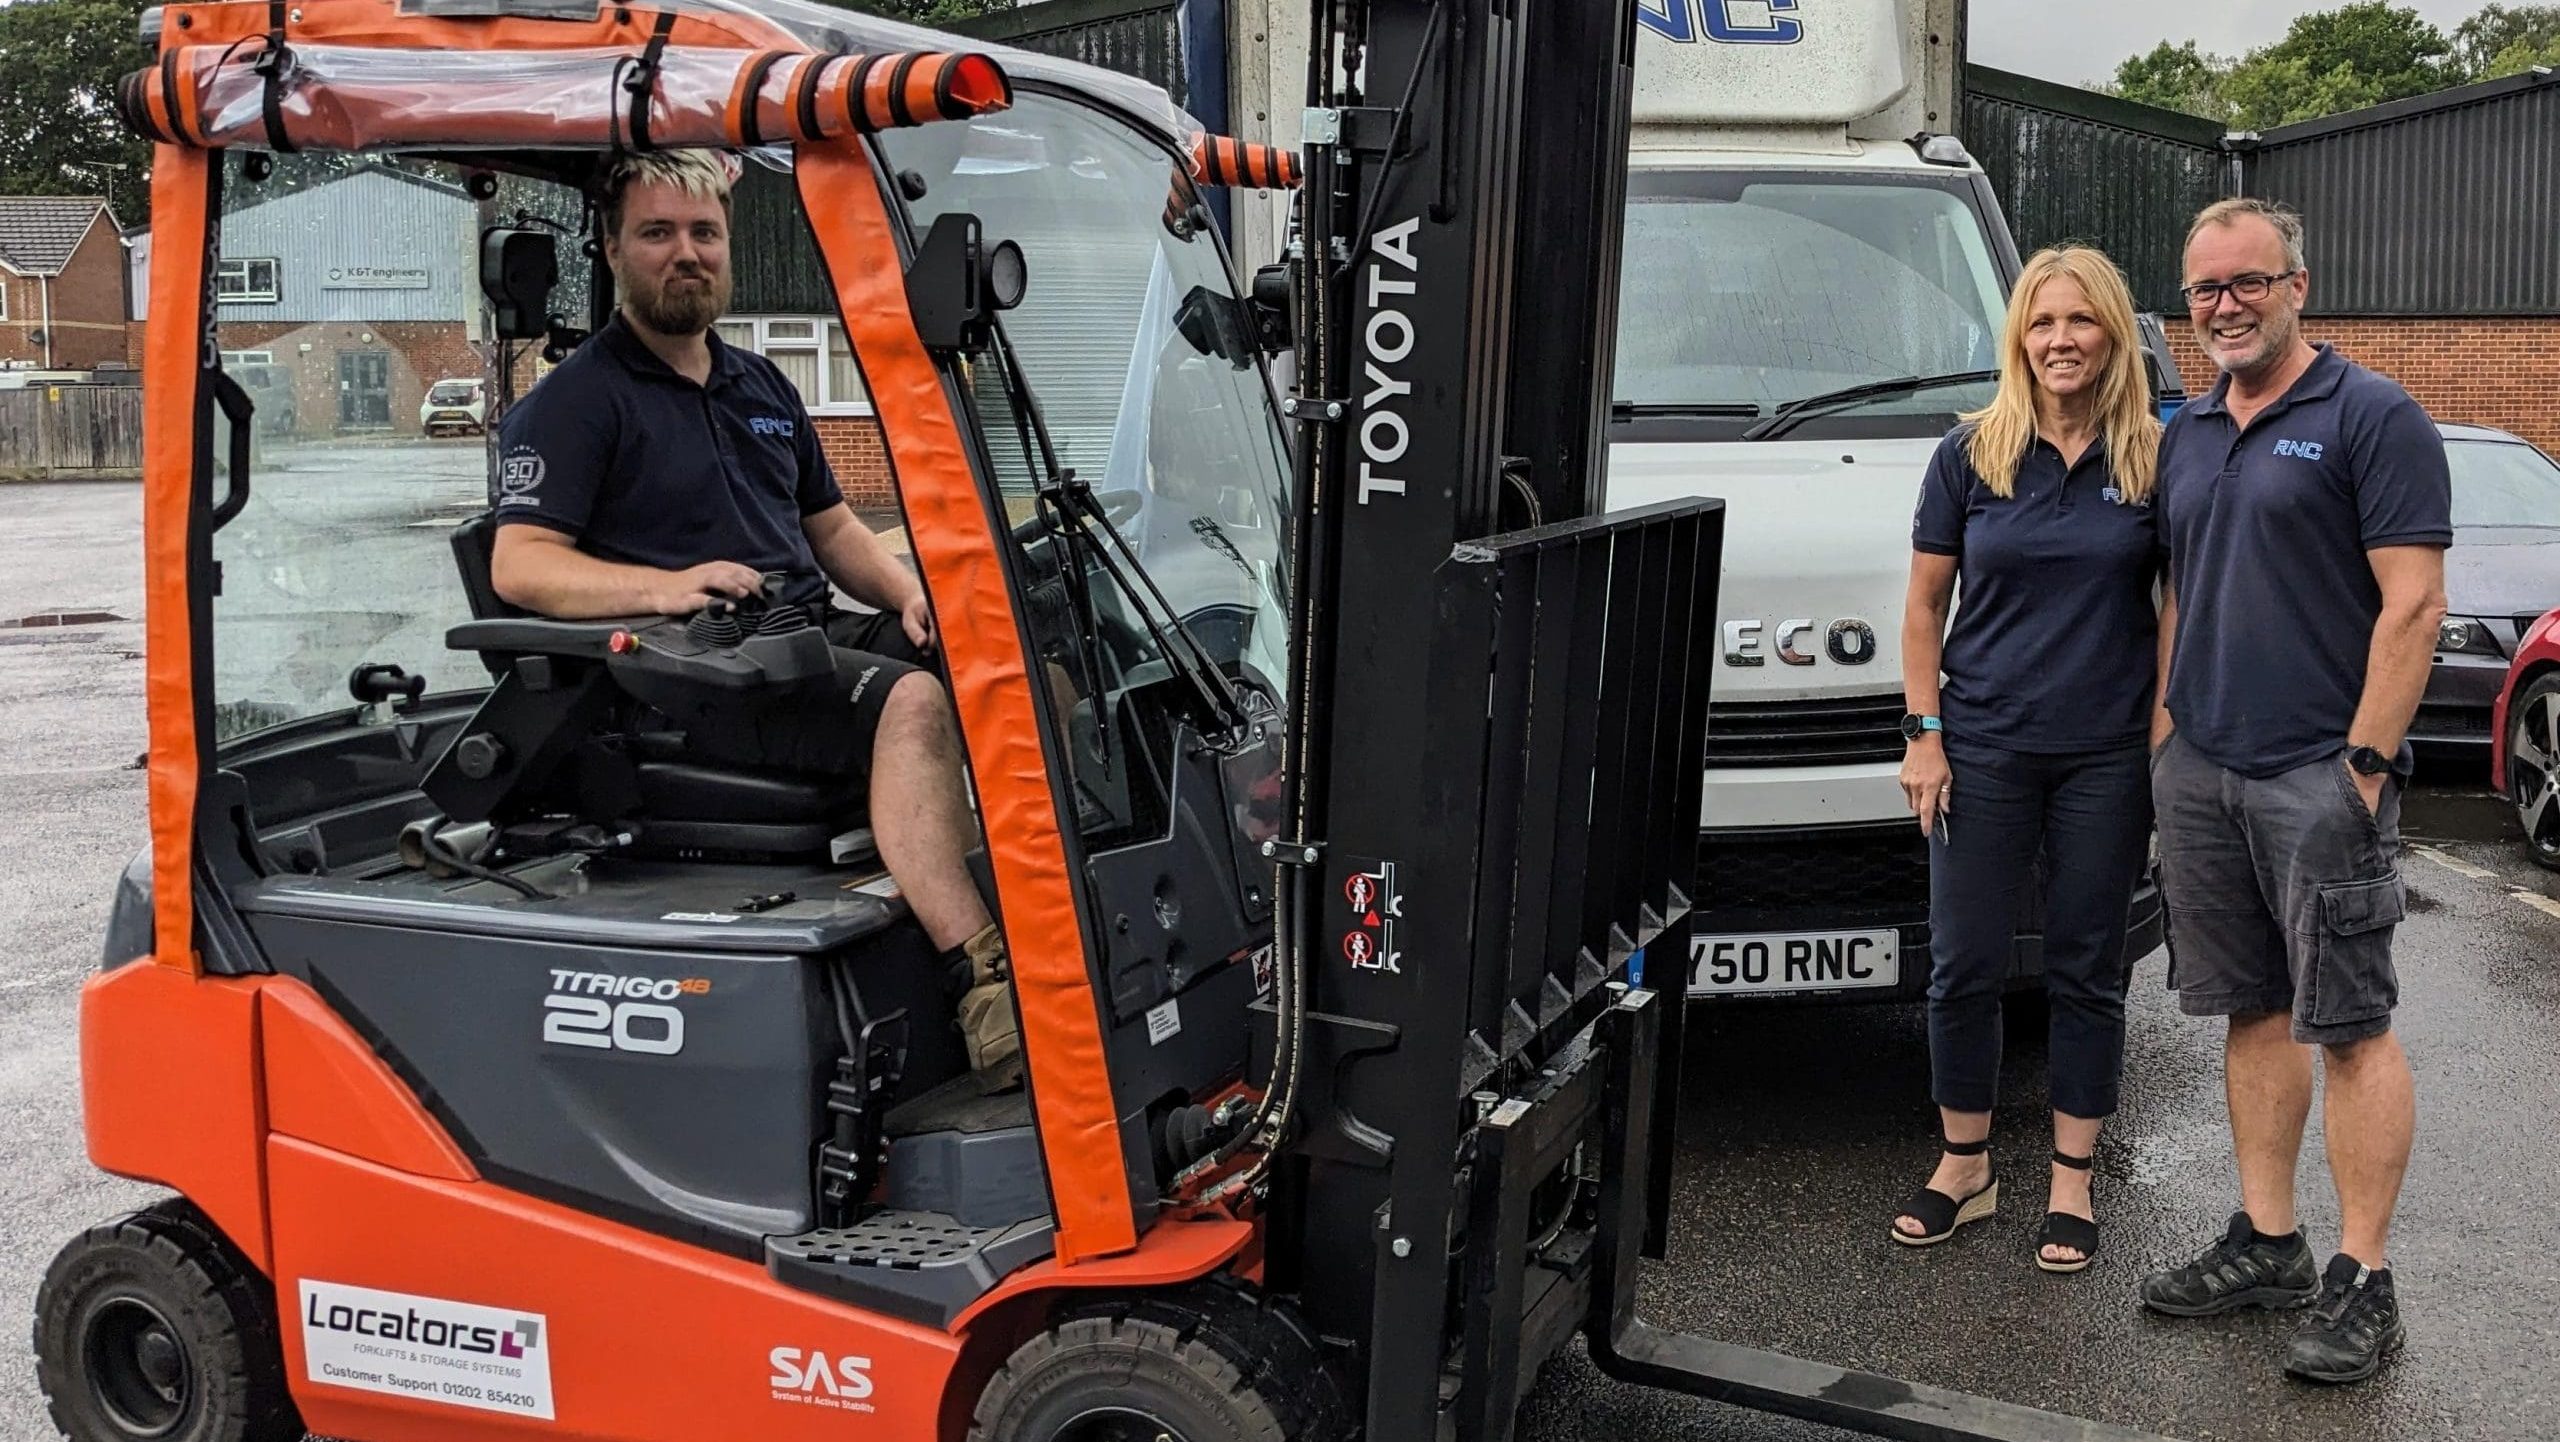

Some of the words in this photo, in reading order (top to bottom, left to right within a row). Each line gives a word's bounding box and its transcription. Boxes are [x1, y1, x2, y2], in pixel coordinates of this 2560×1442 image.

[1358, 216, 1420, 505] TOYOTA
[749, 417, 793, 437] RNC
[2272, 439, 2323, 461] RNC
[506, 462, 534, 479] 30
[1723, 617, 1876, 666] ECO
[1686, 941, 1769, 986] Y50
[1784, 937, 1874, 982] RNC
[543, 994, 685, 1055] 20
[308, 1293, 497, 1354] Locators
[353, 1343, 407, 1361] FORKLIFTS
[410, 1352, 417, 1362] &
[420, 1354, 469, 1370] STORAGE
[472, 1361, 522, 1378] SYSTEMS
[770, 1346, 873, 1398] SAS
[323, 1363, 382, 1384] Customer
[388, 1374, 437, 1393] Support
[443, 1382, 482, 1400] 01202
[487, 1389, 535, 1408] 854210
[771, 1389, 802, 1403] System
[804, 1395, 812, 1404] of
[814, 1396, 839, 1408] Active
[841, 1400, 875, 1413] Stability
